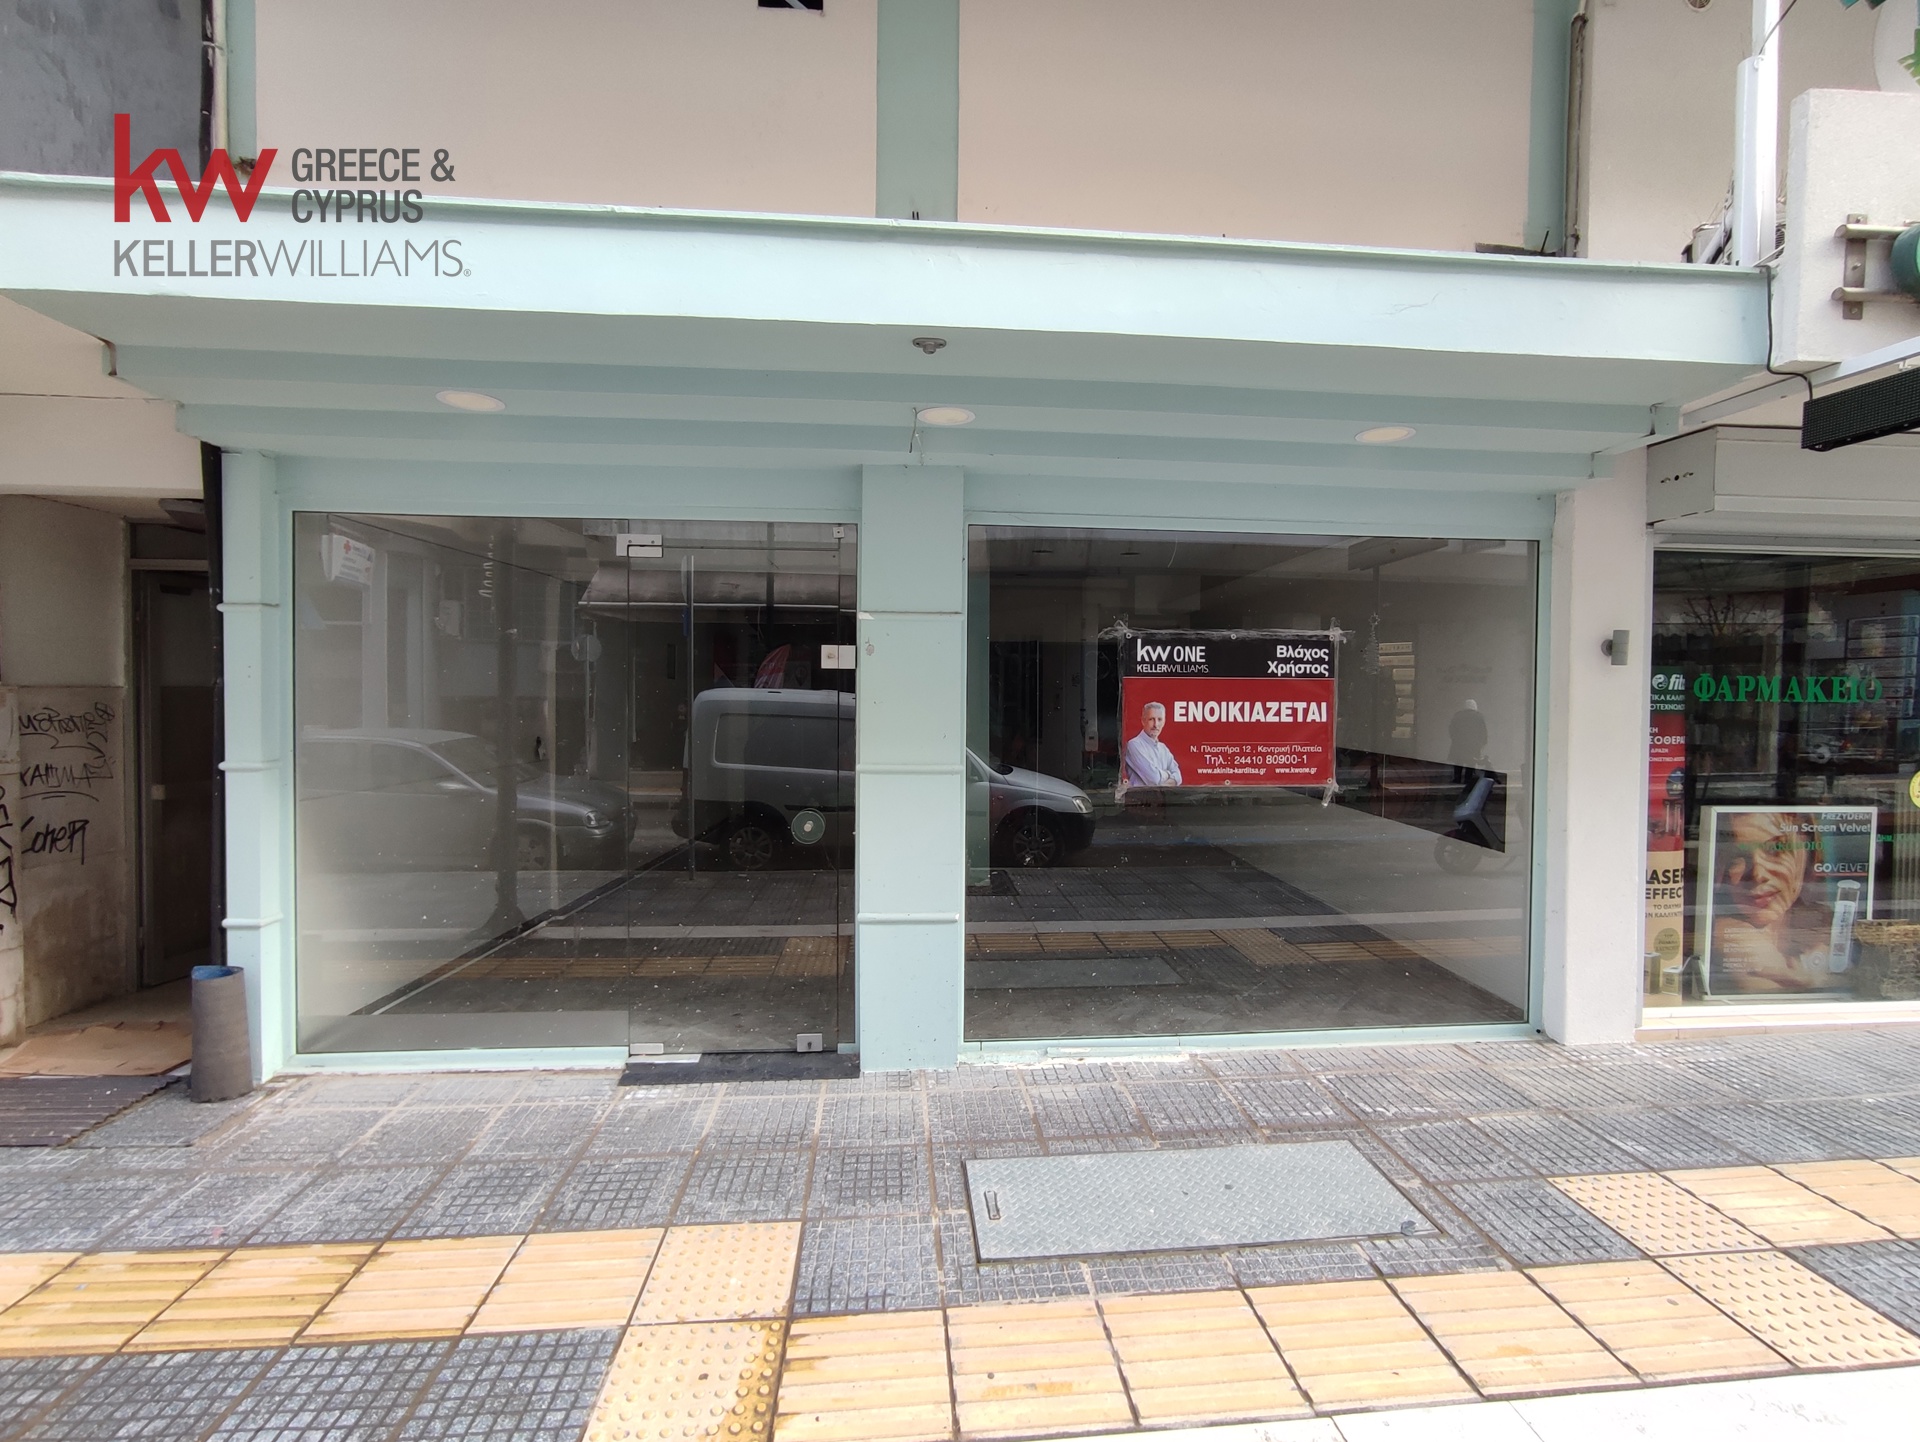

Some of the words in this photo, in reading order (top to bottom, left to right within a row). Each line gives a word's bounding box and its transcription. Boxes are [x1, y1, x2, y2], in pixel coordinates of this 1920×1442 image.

[1136, 638, 1171, 662] kw
[1173, 646, 1206, 663] ONE
[1276, 644, 1329, 661] Βλάχος
[1136, 664, 1209, 673] KELLERWILLIAMS
[1267, 660, 1329, 677] Χρήστος
[1693, 673, 1883, 703] ΦΑΡΜΑΚΕΙΟ
[1173, 701, 1327, 723] ΕΝΟΙΚΙΑΖΕΤΑΙ
[1201, 745, 1240, 753] Πλαστήρα
[1242, 745, 1251, 753] 12
[1257, 745, 1290, 753] Κεντρική
[1291, 744, 1322, 753] Πλατεία
[1234, 755, 1262, 764] 24410
[1265, 754, 1307, 764] 80900-1
[1197, 767, 1267, 775] www.akinita-karditsa.gr
[1275, 766, 1318, 774] www.kwone.gr
[1780, 823, 1799, 832] Sun
[1801, 824, 1836, 832] Screen
[1839, 823, 1871, 832] Velvet
[1814, 862, 1869, 873] GOVELVET
[1645, 886, 1684, 899] EFFEC
